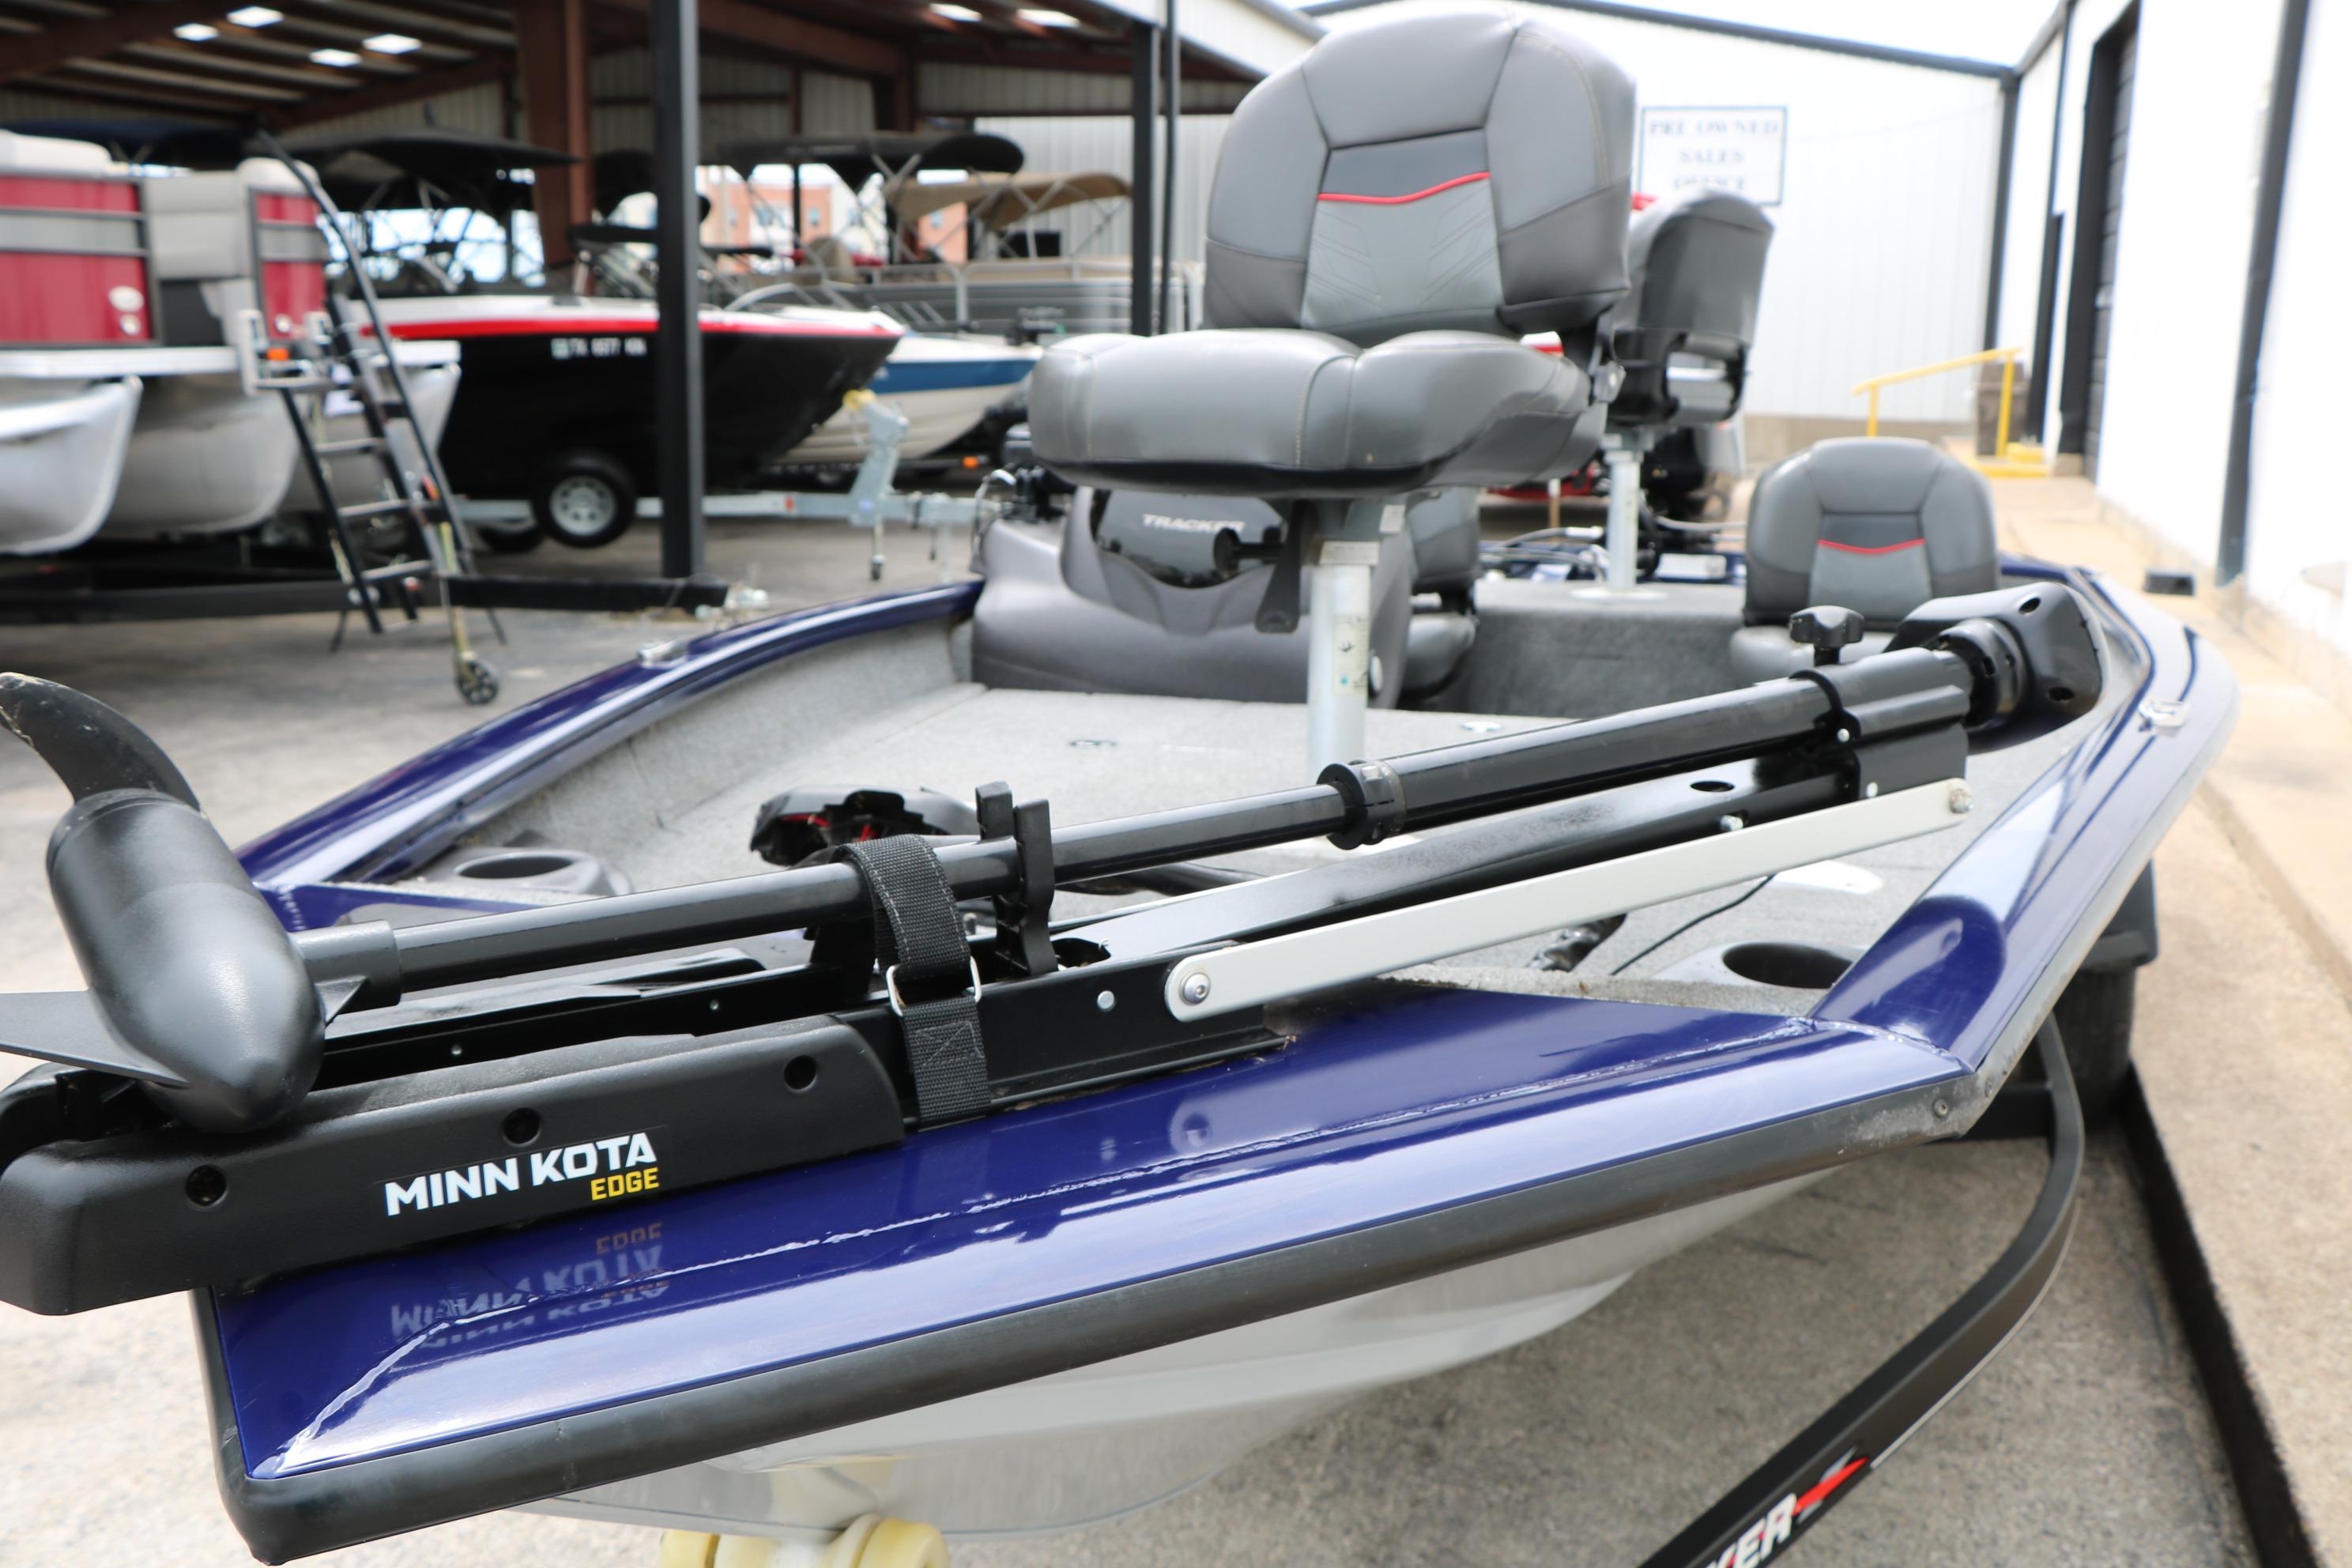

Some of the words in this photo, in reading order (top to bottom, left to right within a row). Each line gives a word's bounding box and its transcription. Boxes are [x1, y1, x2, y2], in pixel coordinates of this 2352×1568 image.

[385, 1157, 520, 1216] MINN
[530, 1132, 658, 1186] KOTA
[590, 1167, 661, 1201] EDGE
